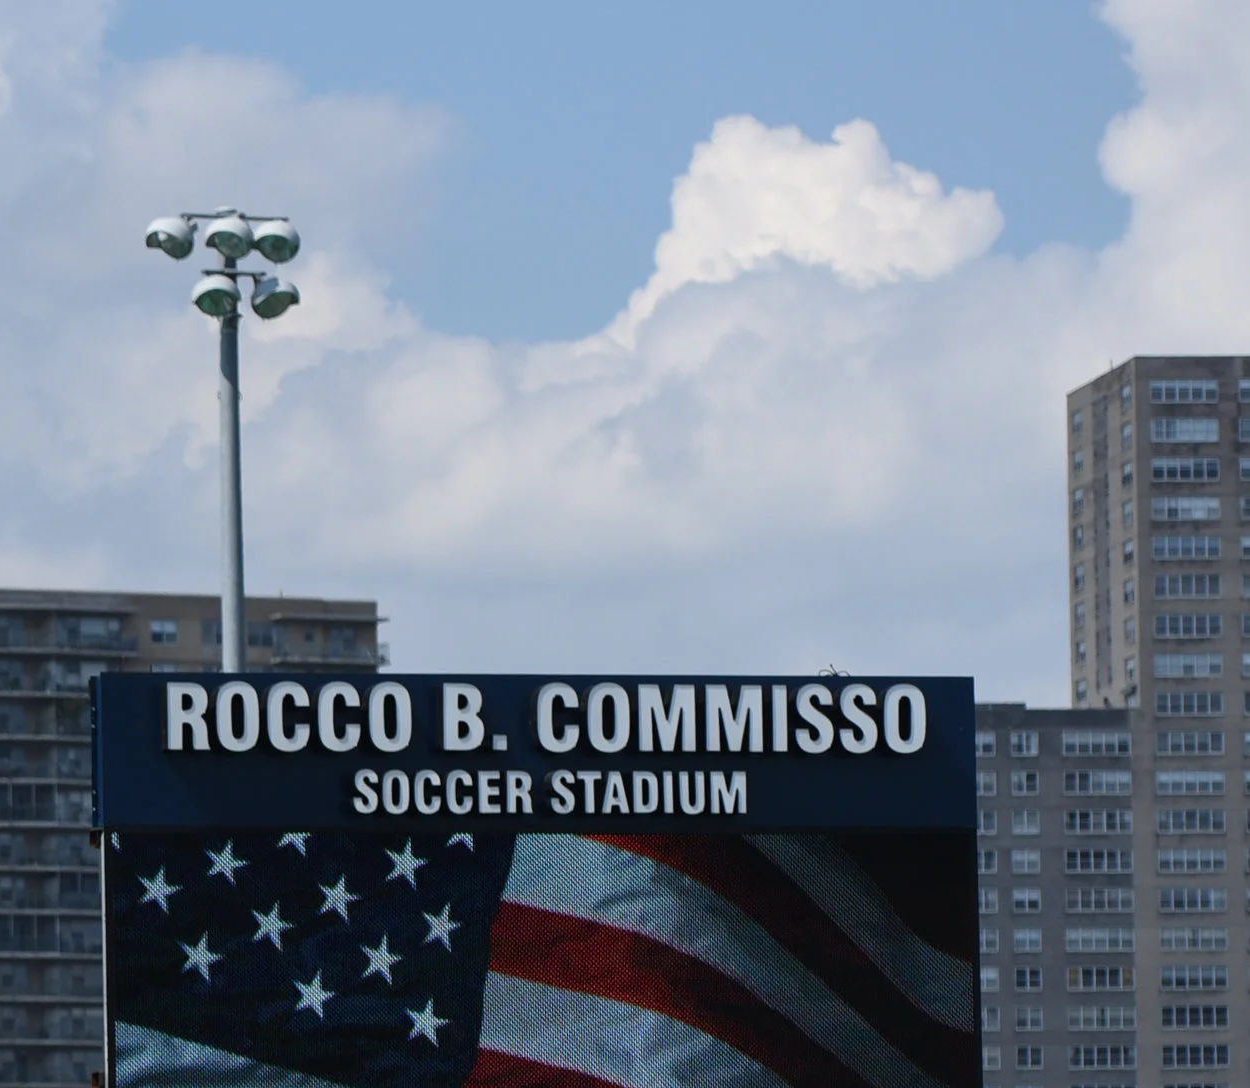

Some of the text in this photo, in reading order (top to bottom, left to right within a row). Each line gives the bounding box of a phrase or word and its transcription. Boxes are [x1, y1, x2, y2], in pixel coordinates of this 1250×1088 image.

[165, 681, 927, 755] ROCCO B. COMMISSO
[353, 769, 748, 815] SOCCER STADIUM
